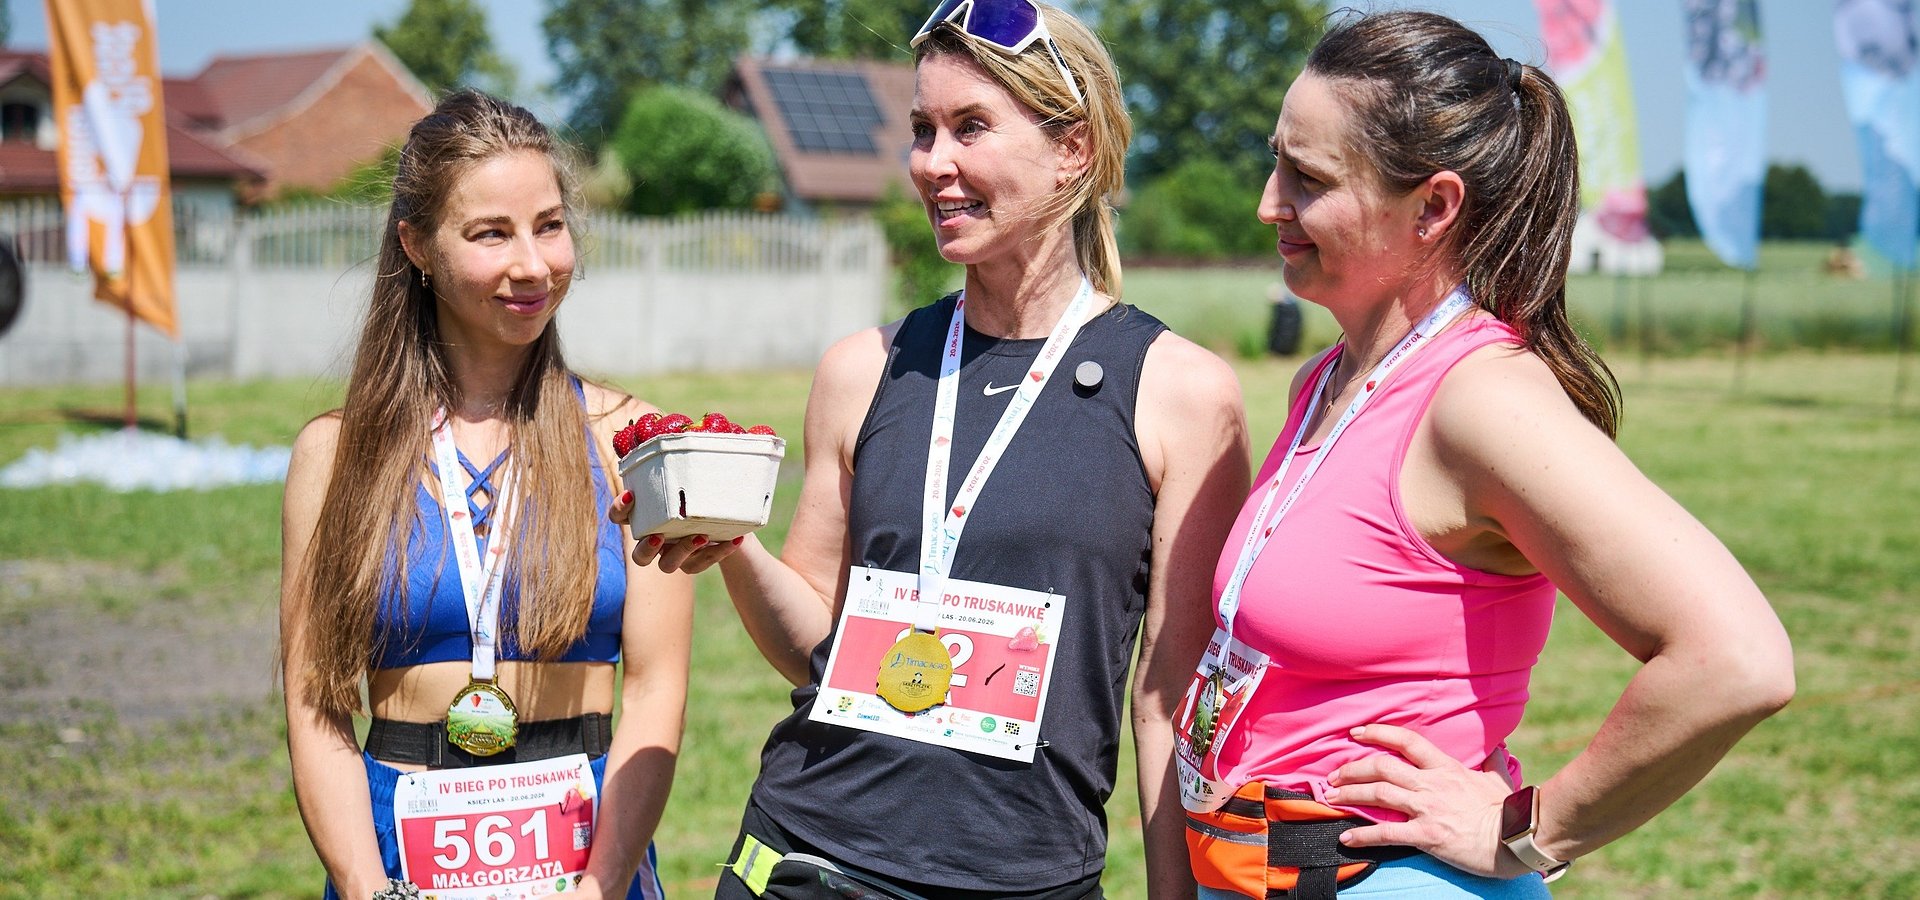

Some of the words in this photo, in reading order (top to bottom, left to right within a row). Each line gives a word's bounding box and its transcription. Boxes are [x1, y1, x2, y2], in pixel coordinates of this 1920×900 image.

[966, 456, 991, 493] 20.06.2026
[894, 587, 908, 600] IV
[942, 594, 960, 607] PO
[964, 596, 1046, 623] TRUSKAWKĘ
[958, 615, 995, 625] 20.06.2026
[439, 783, 451, 795] IV
[455, 779, 484, 794] BIEG
[489, 778, 506, 791] PO
[510, 792, 545, 802] 20.06.2026
[433, 809, 550, 870] 561
[432, 860, 565, 889] MAŁGORZATA
